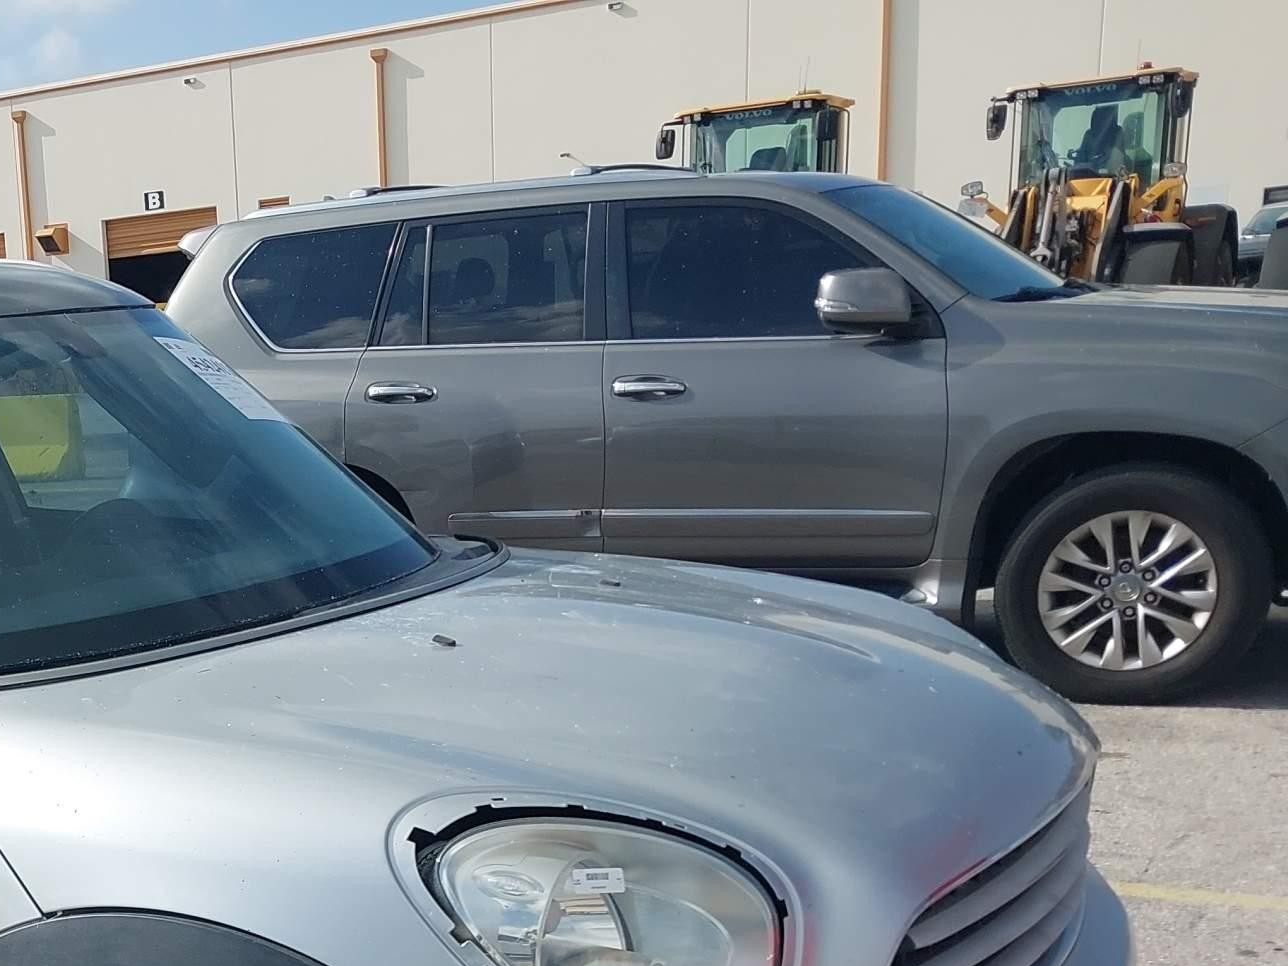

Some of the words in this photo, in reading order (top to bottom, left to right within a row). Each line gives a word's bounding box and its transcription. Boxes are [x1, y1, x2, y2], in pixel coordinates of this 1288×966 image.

[1064, 82, 1117, 96] VOLVO
[725, 109, 772, 121] VOLVO
[148, 192, 161, 210] B
